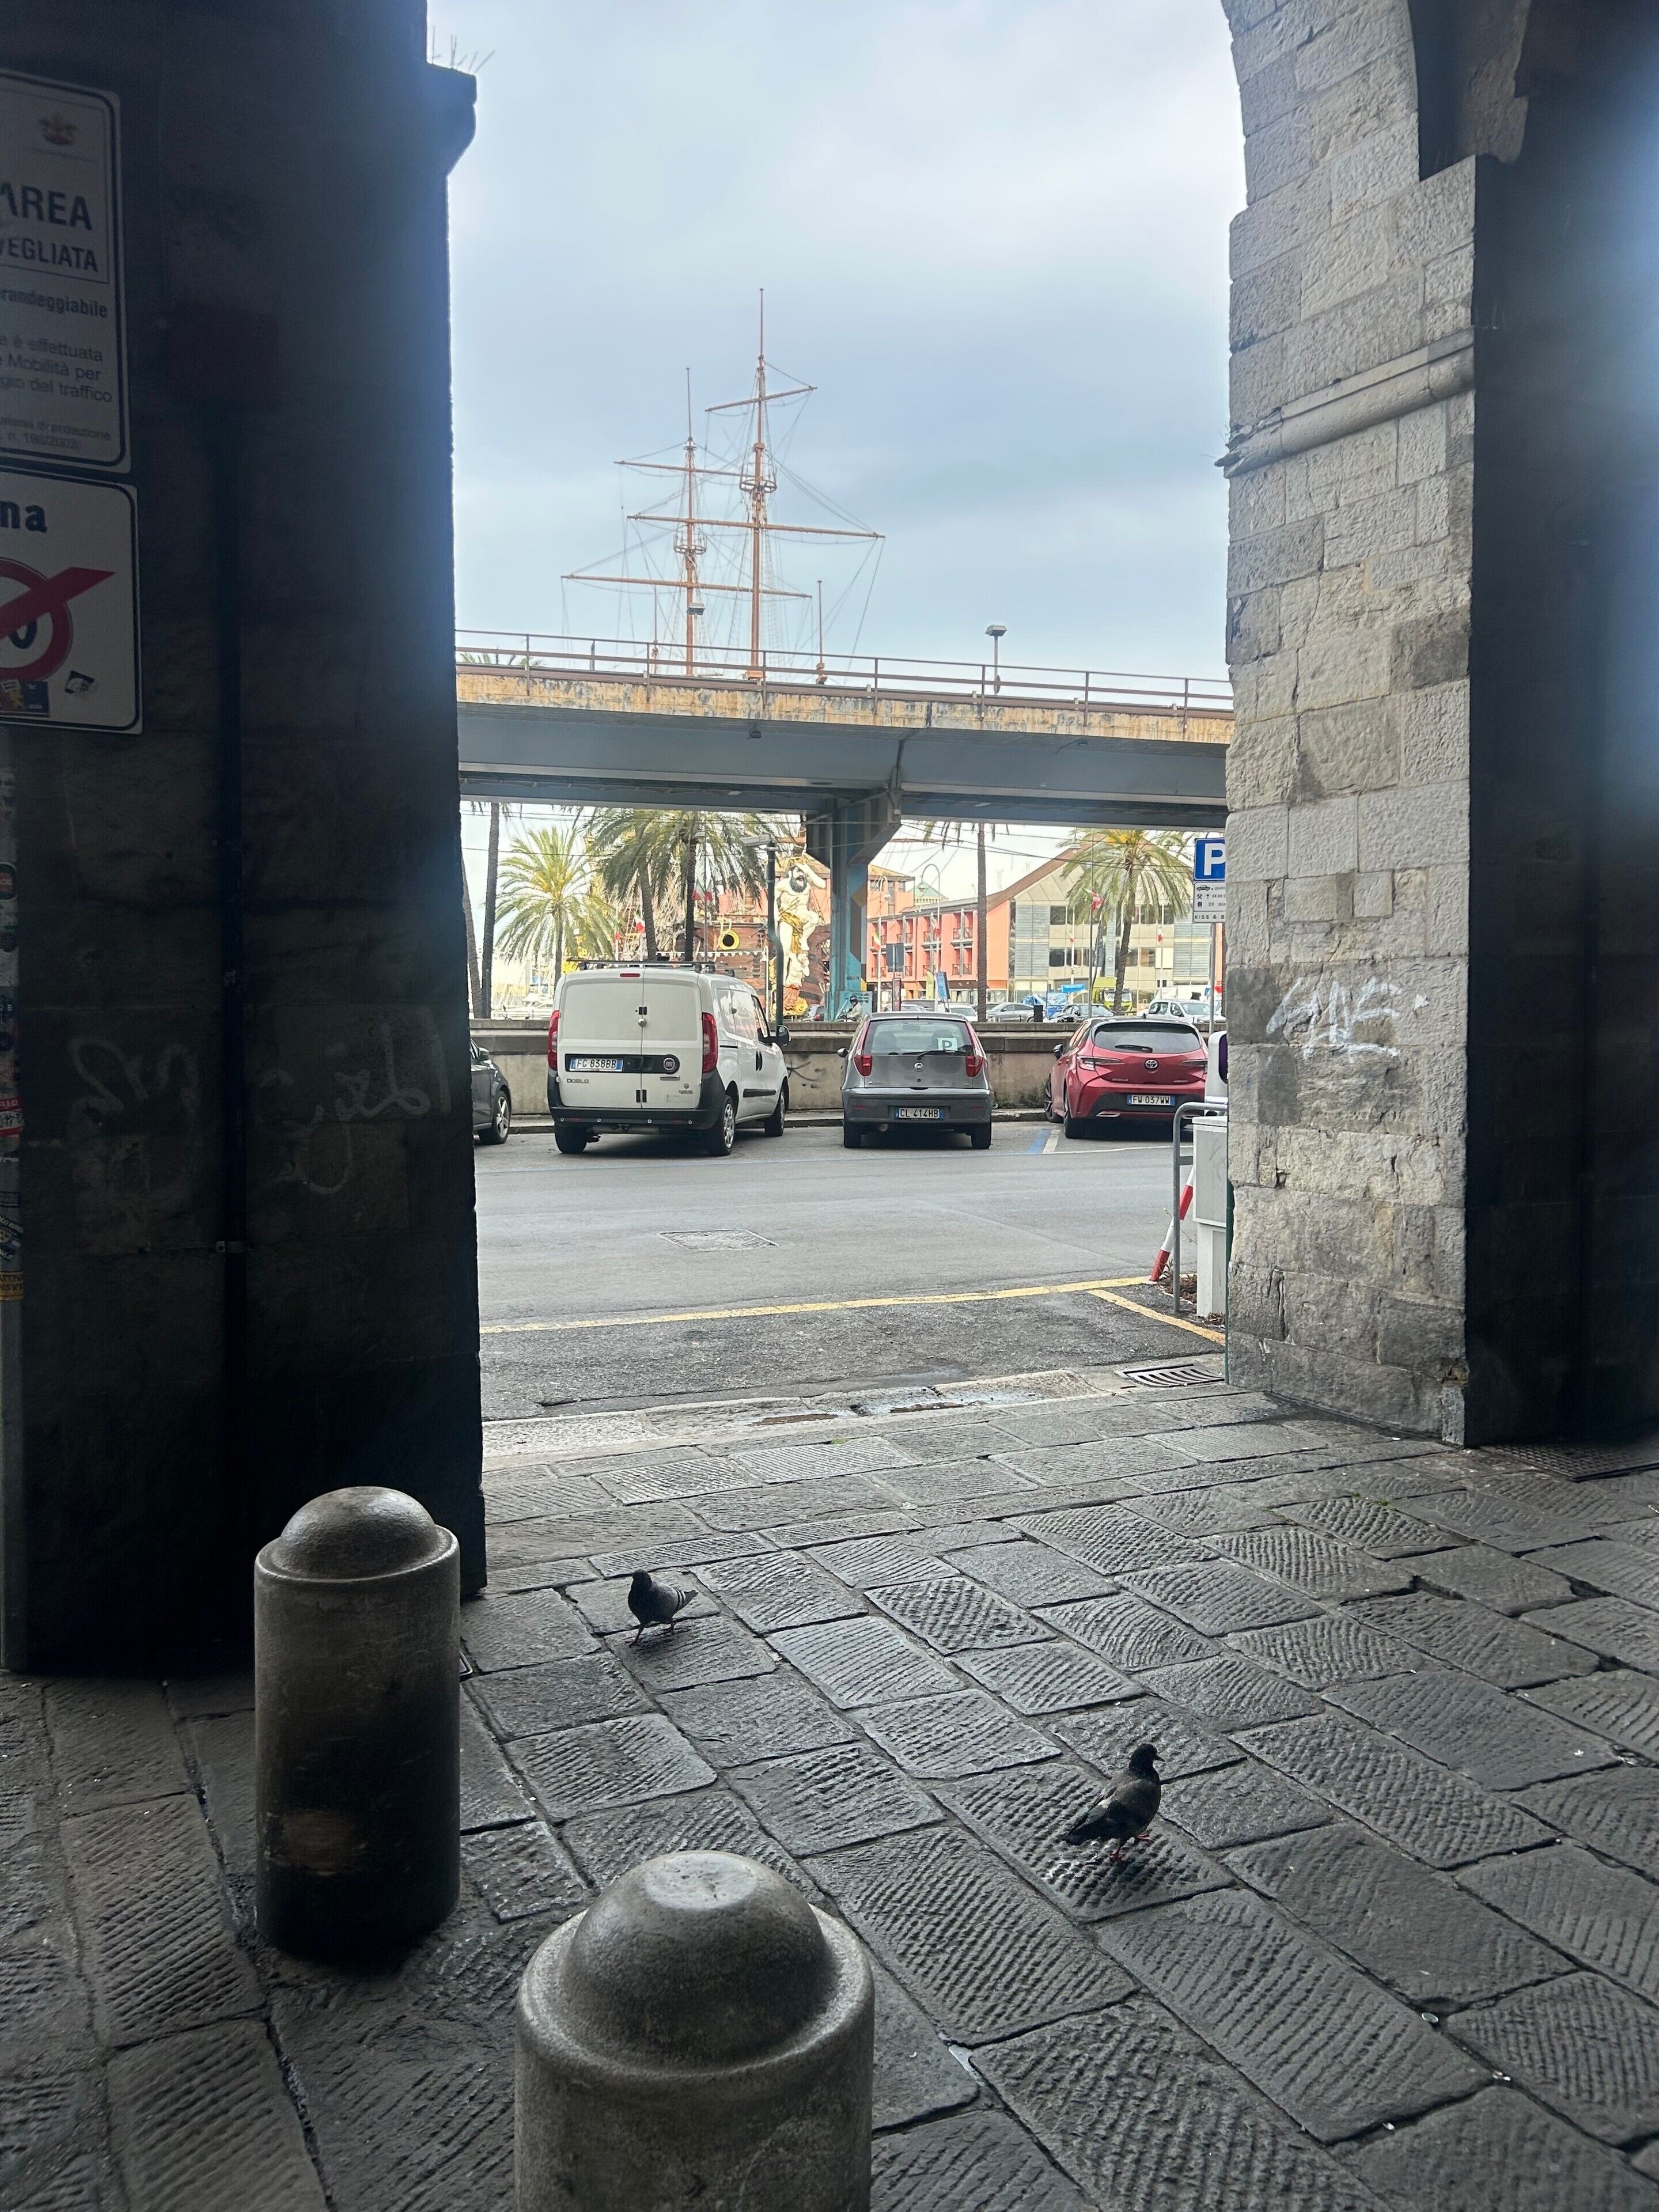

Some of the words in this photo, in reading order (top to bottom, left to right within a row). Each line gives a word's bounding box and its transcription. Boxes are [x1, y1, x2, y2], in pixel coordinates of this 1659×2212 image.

[76, 368, 101, 381] per
[59, 382, 112, 403] traffico
[1204, 843, 1226, 876] P
[577, 1059, 588, 1068] FG
[590, 1059, 616, 1069] 838BB
[900, 1109, 910, 1117] CL
[913, 1109, 939, 1118] 414HB
